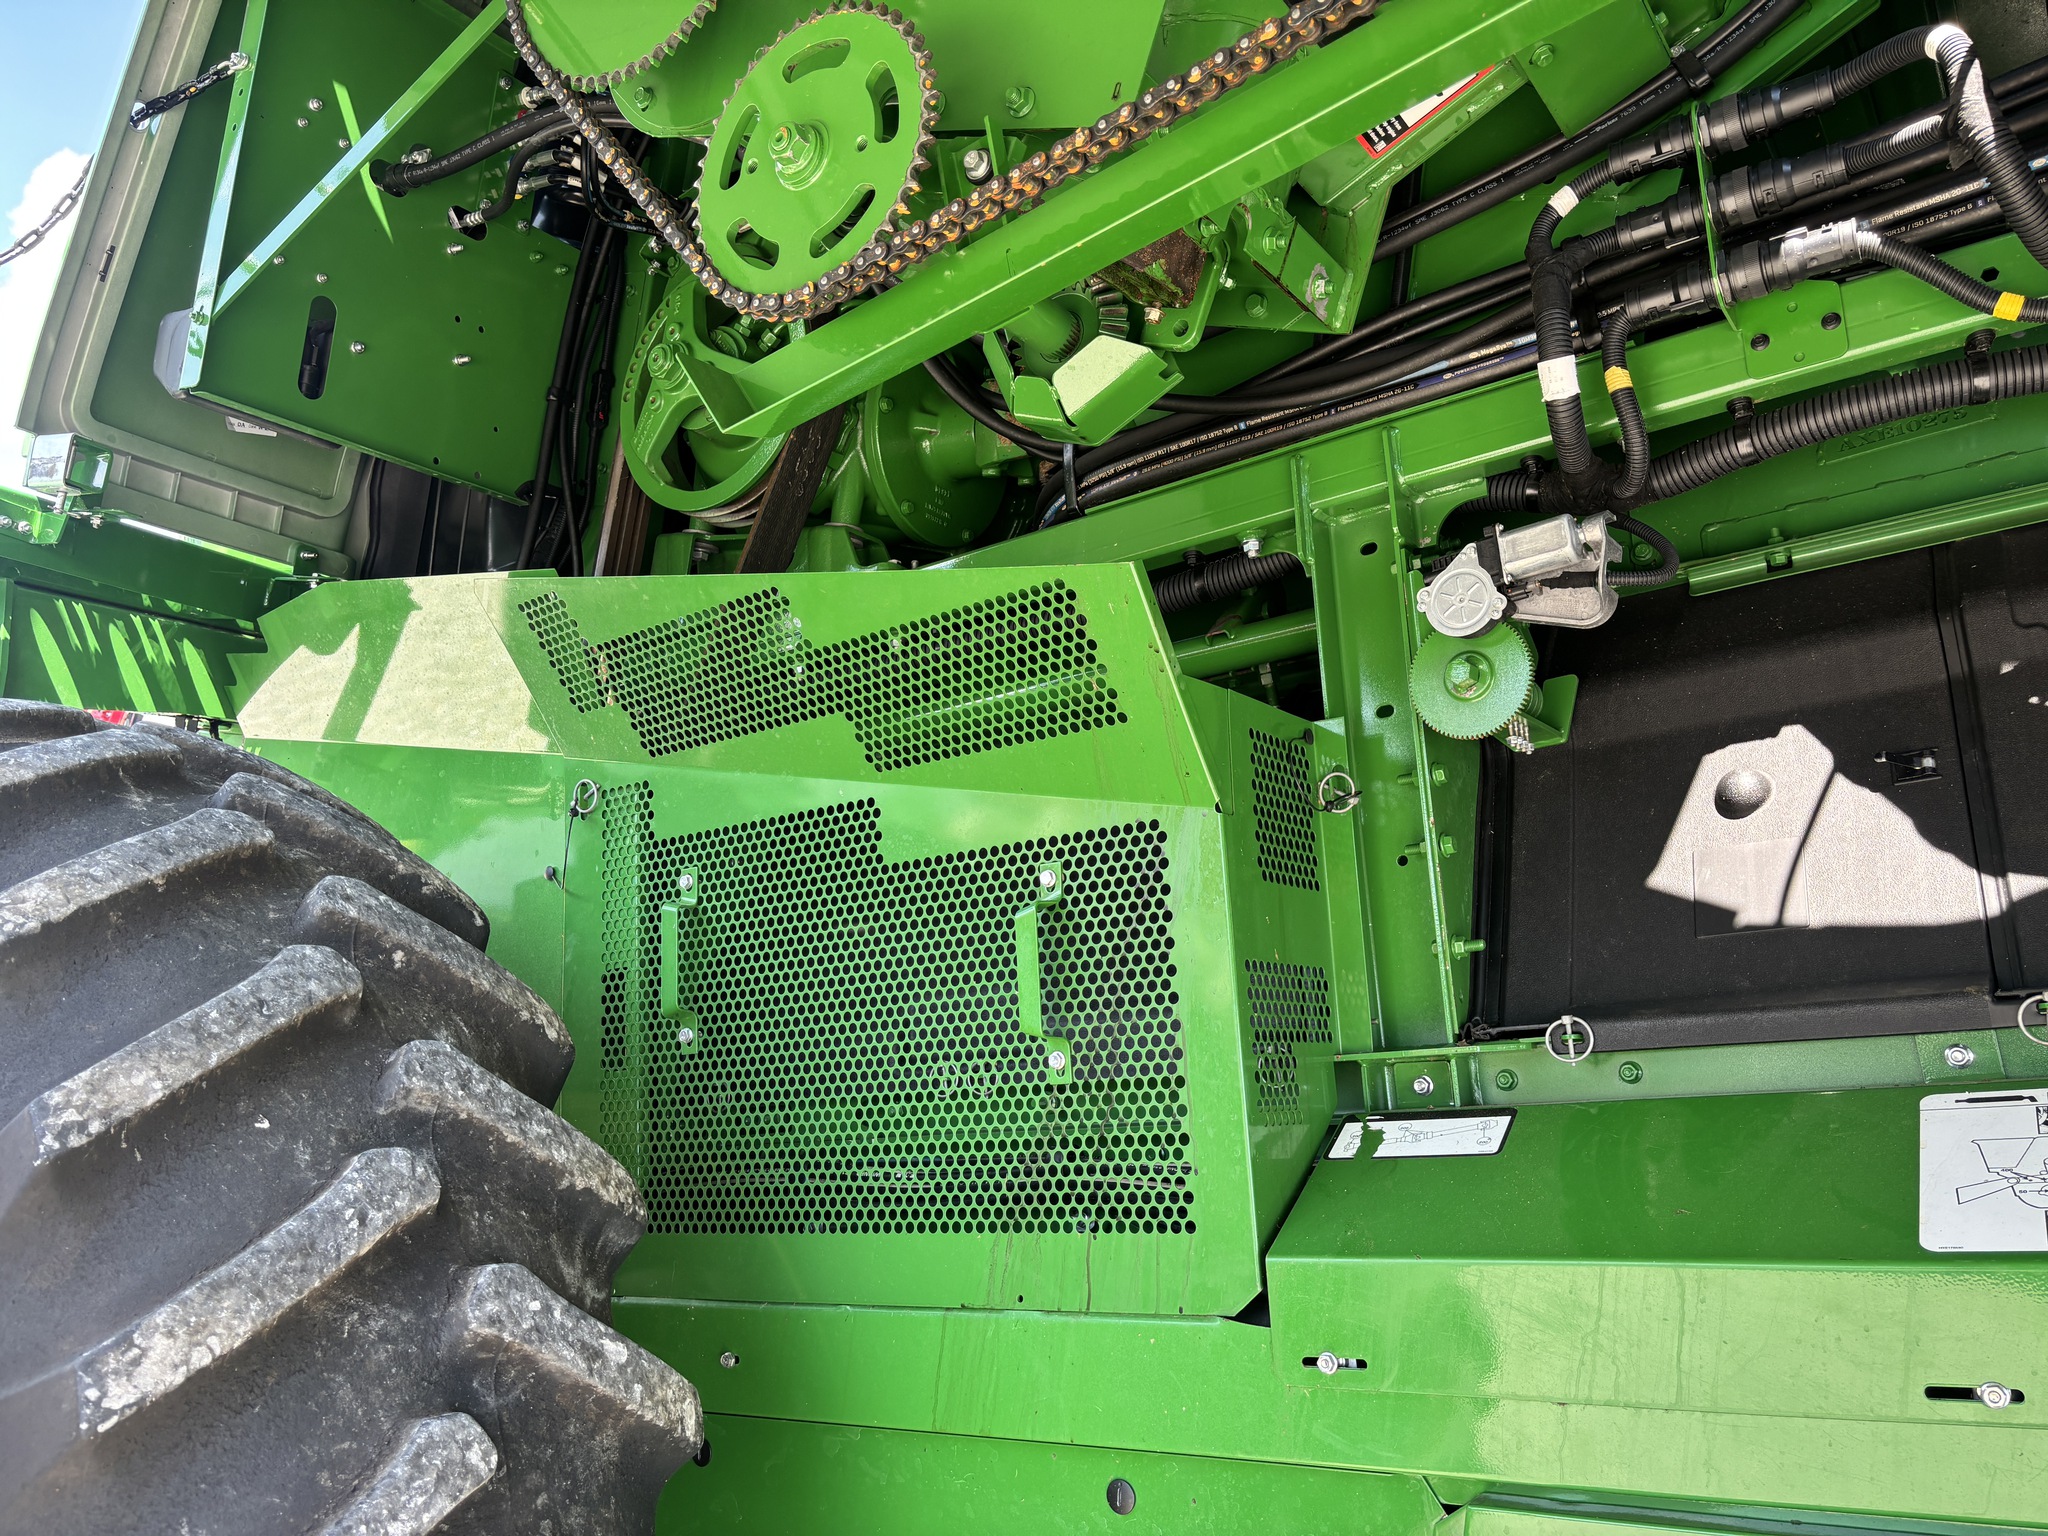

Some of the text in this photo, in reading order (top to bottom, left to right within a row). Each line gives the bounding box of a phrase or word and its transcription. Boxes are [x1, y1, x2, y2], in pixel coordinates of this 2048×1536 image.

[1762, 0, 1776, 10] J30
[461, 147, 472, 157] TYPE
[1451, 196, 1467, 207] TYPE
[1477, 181, 1498, 194] CLASS
[1871, 181, 1980, 225] Flame Resistant MSHA 2G-11C
[1911, 219, 1924, 228] ISO
[1925, 211, 1948, 224] 18752
[1949, 205, 1966, 216] Type
[1295, 416, 1311, 424] 18752
[1312, 412, 1323, 420] Type
[1337, 402, 1353, 411] Flame
[1353, 395, 1378, 407] Resistant
[1378, 390, 1393, 399] MSHA
[1394, 384, 1414, 394] 2G-11C
[1179, 438, 1196, 448] 100R17
[1199, 434, 1207, 442] ISO
[1208, 429, 1222, 439] 18752
[1223, 426, 1234, 435] Type
[1246, 417, 1261, 426] Flame
[1261, 411, 1284, 421] Resistant
[1838, 407, 1968, 453] AXE10275
